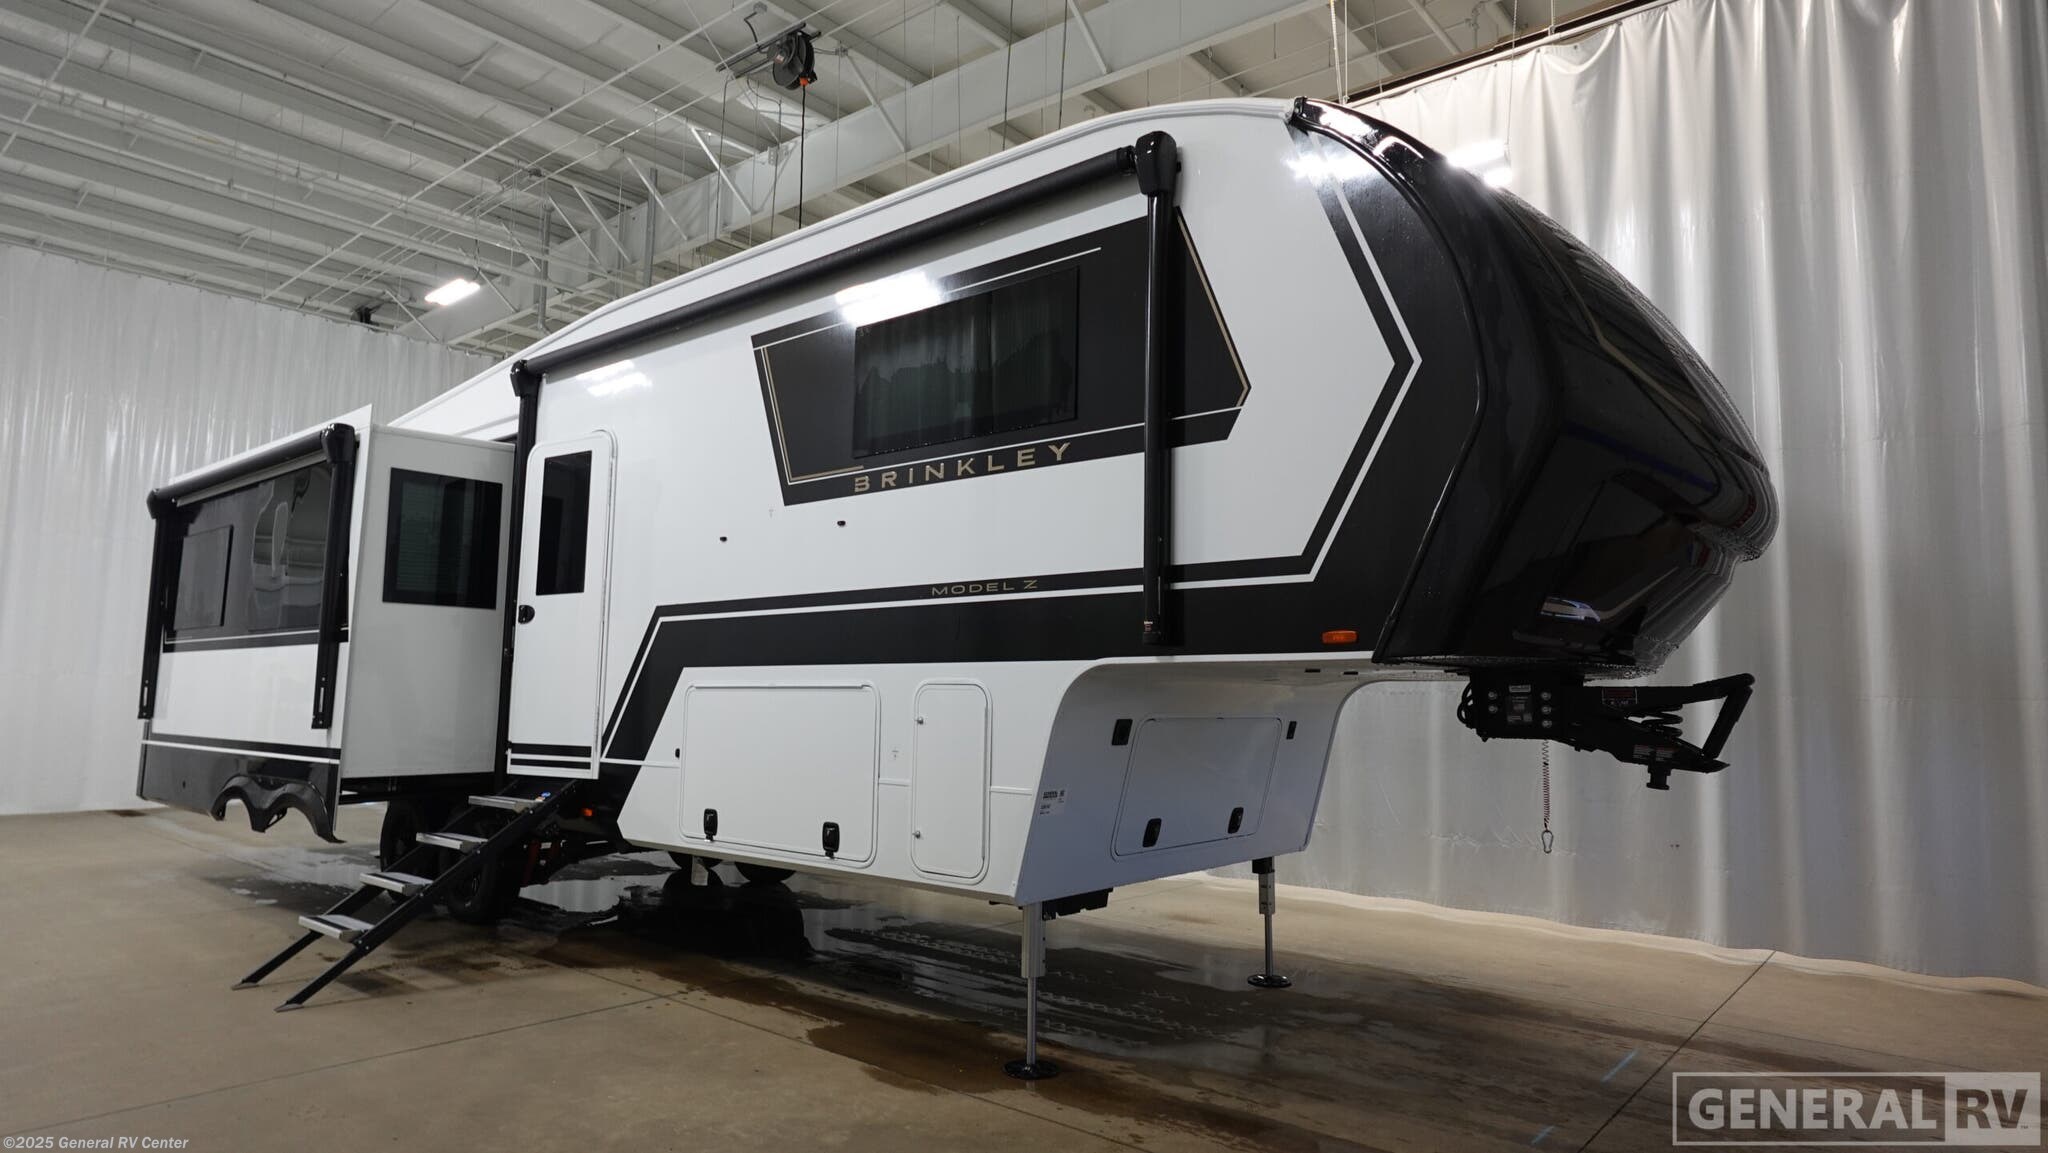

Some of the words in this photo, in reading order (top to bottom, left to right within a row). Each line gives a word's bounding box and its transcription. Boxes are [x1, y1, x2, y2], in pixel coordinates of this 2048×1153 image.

[854, 442, 1070, 493] BRINKLEY
[931, 581, 1015, 596] MODEL
[1023, 579, 1038, 589] Z
